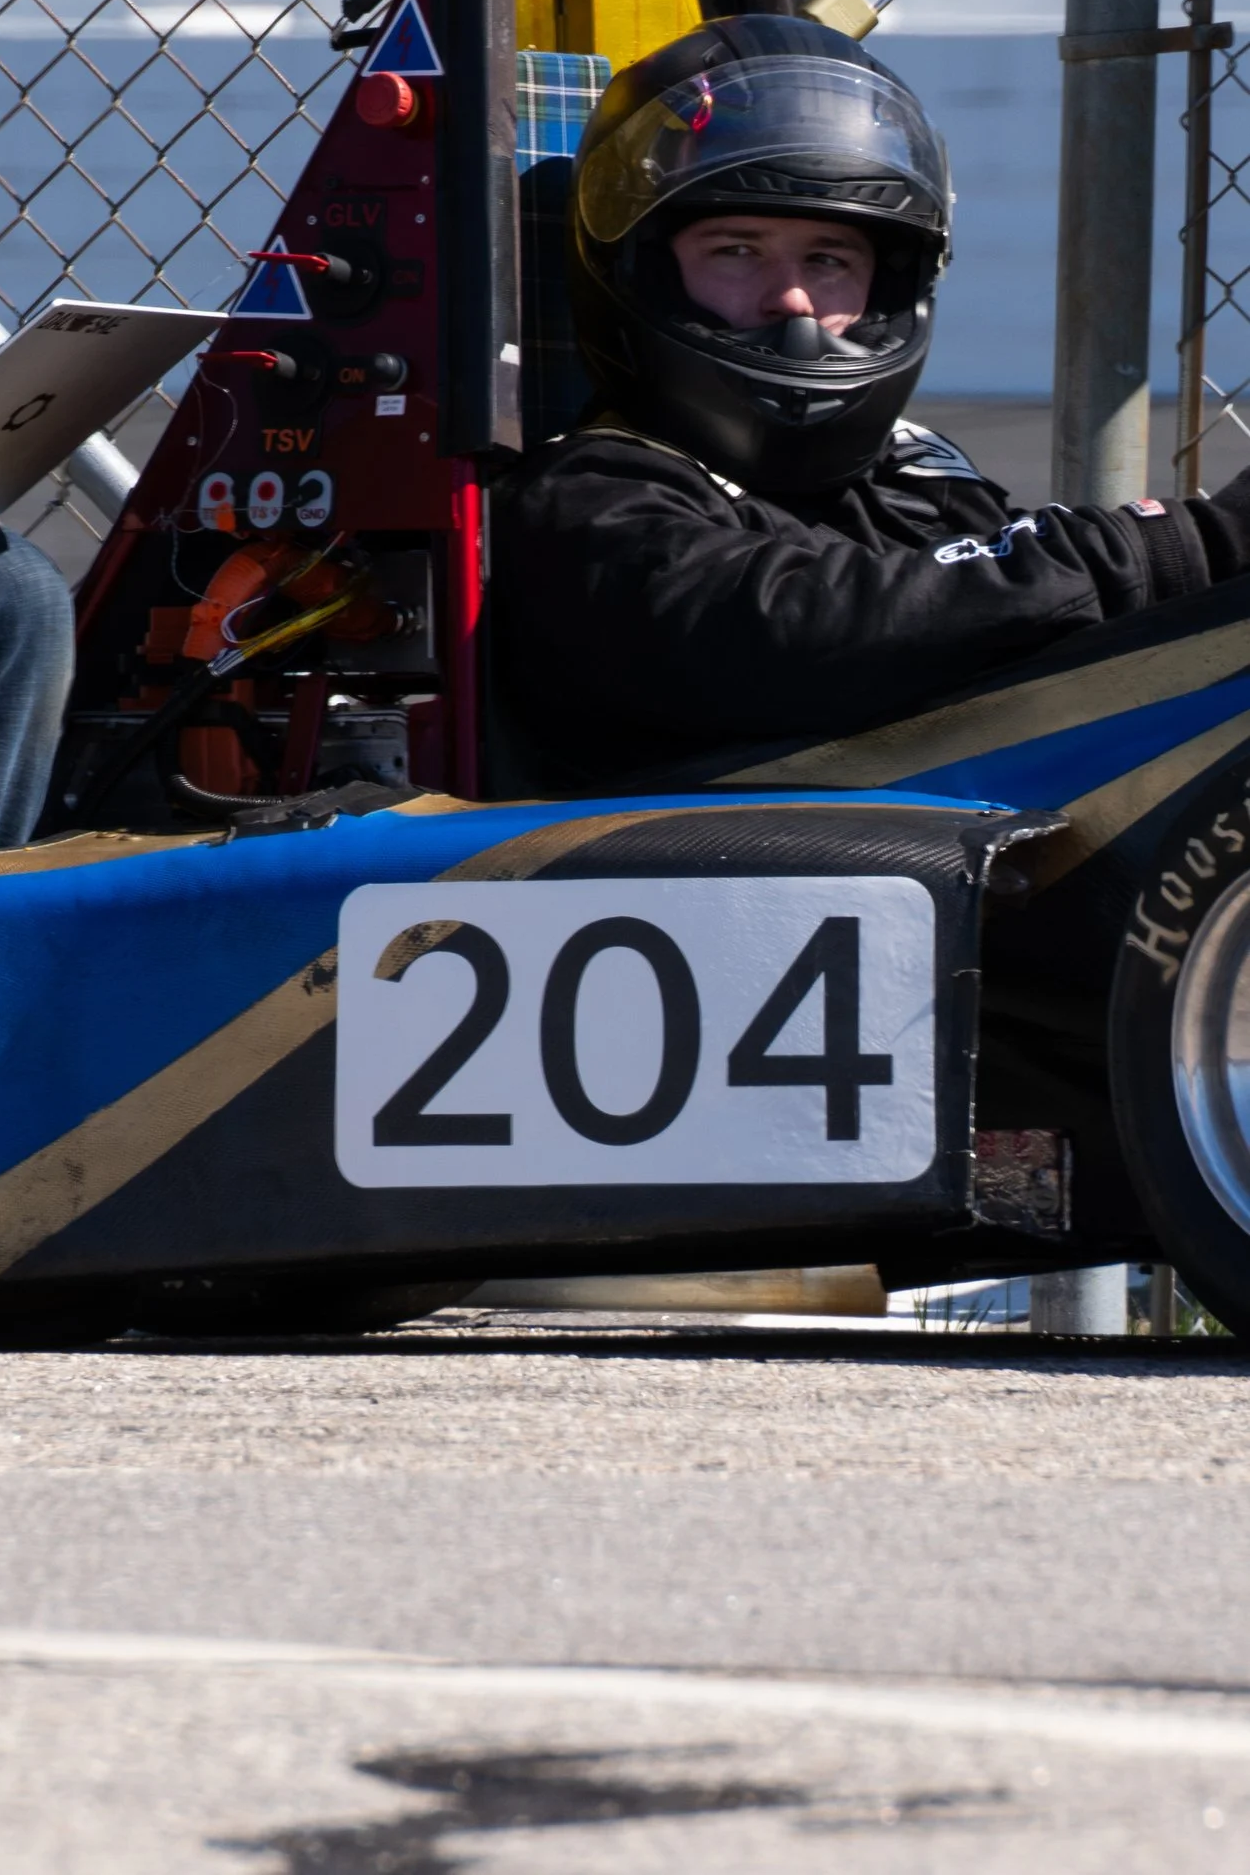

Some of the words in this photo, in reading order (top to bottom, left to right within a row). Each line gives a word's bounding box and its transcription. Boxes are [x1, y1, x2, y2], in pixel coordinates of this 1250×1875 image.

[324, 202, 383, 227] GLV
[338, 367, 367, 384] ON
[261, 427, 316, 453] TSV
[299, 507, 326, 520] GND
[371, 914, 894, 1148] 204
